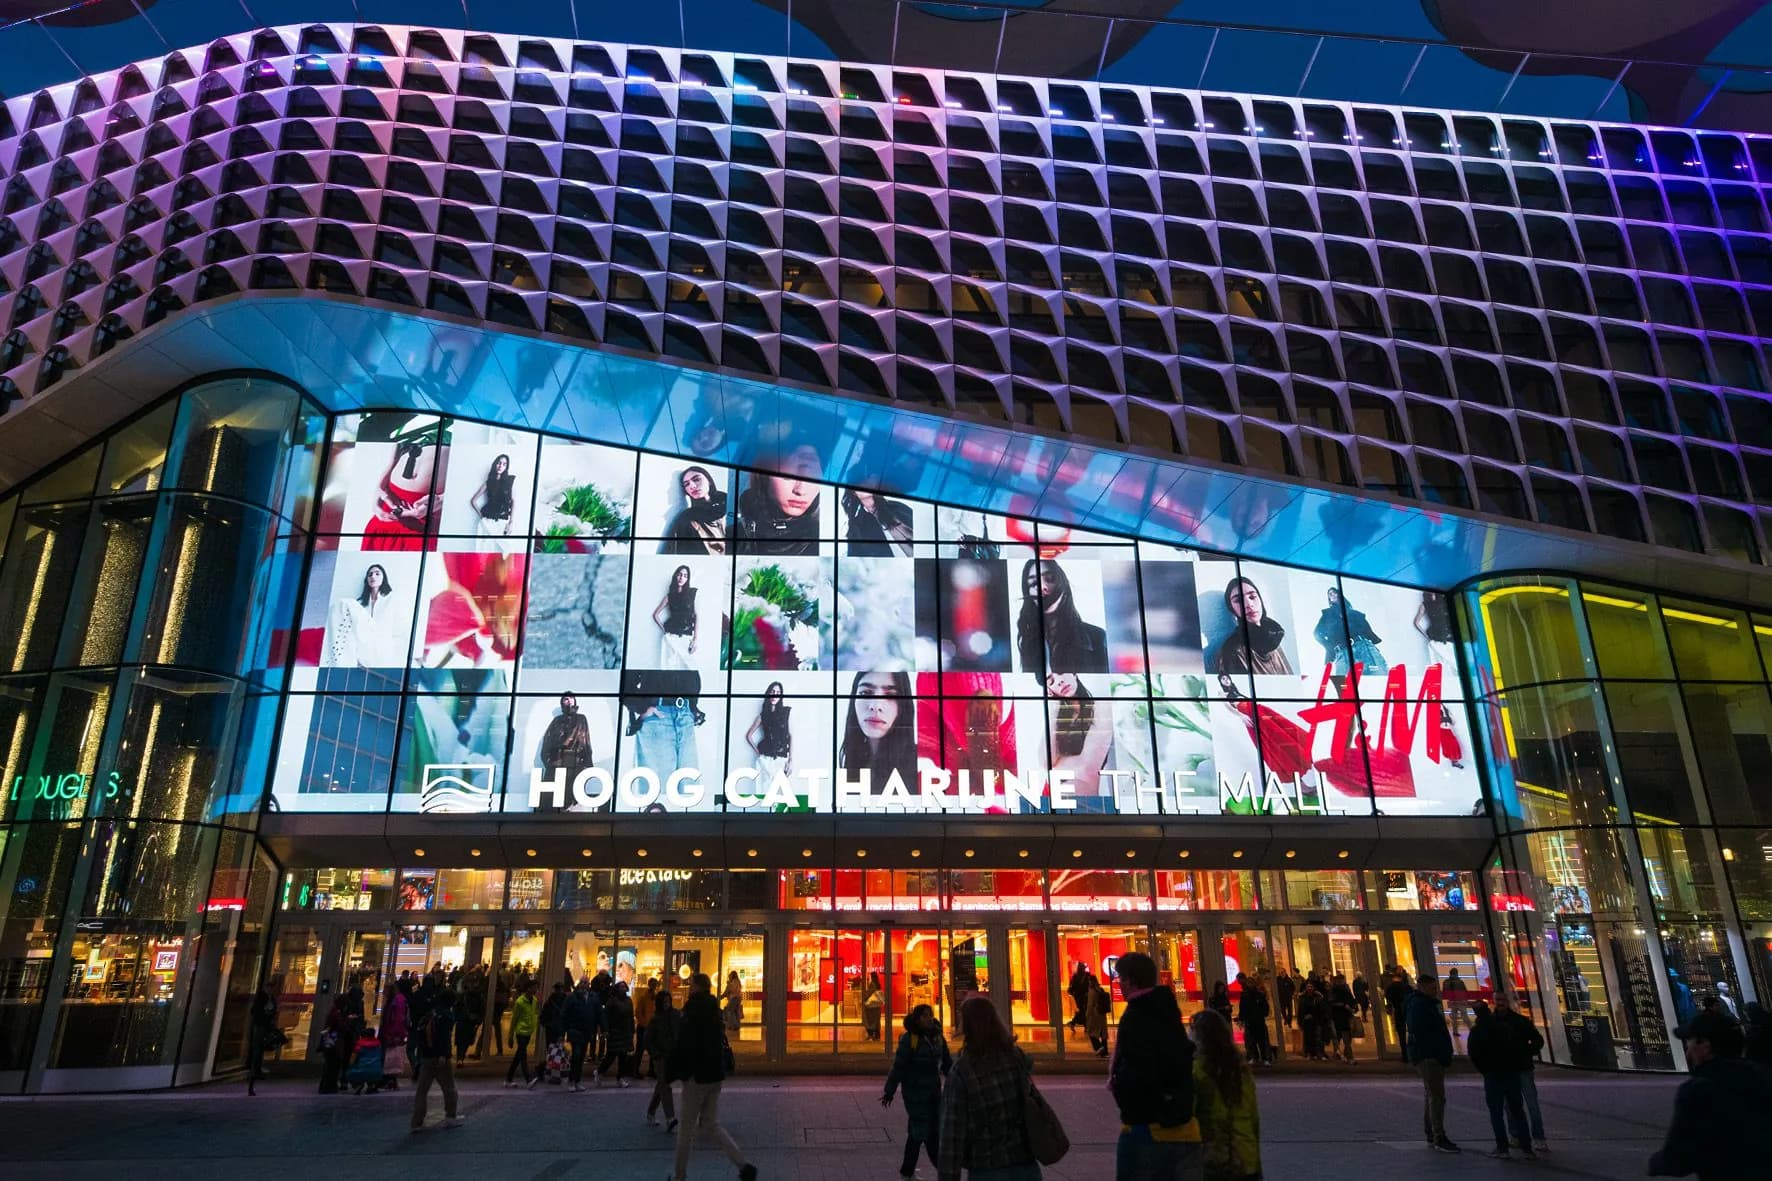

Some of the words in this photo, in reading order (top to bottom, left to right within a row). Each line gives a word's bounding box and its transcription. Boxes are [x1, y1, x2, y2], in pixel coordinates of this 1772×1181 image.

[1297, 662, 1442, 765] H&M
[10, 771, 120, 801] UGLS
[528, 766, 705, 809] HOOG
[724, 767, 1077, 810] CATHARIJNE
[1097, 770, 1200, 811] THE
[1217, 770, 1349, 811] MALL
